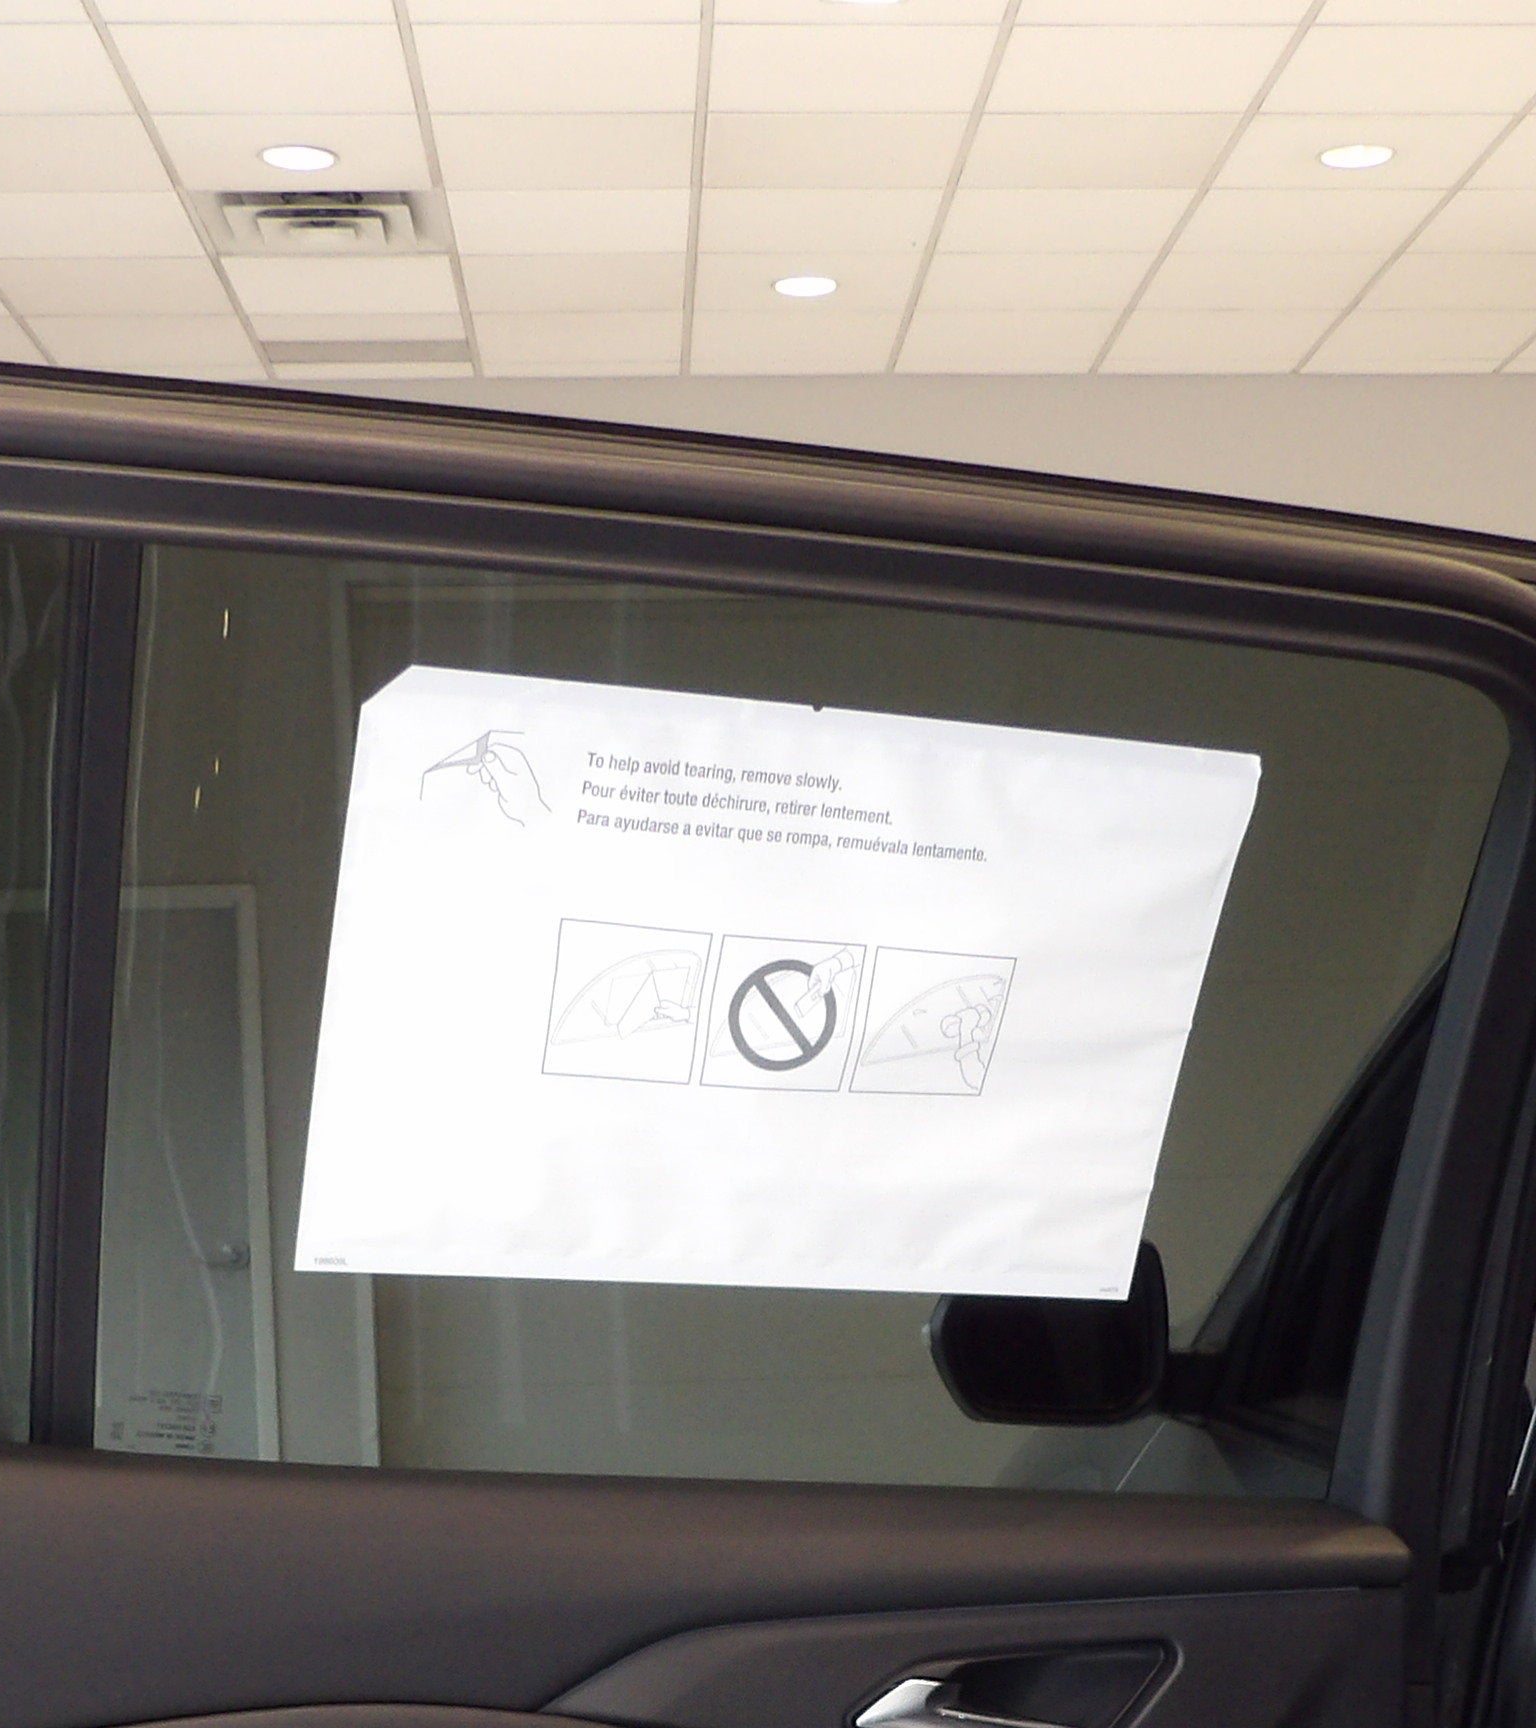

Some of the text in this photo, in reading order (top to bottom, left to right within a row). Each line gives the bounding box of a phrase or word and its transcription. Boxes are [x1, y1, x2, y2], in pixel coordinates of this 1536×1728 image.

[587, 752, 842, 793] To help avoid tearing, remove slowly.
[582, 780, 893, 825] Pour éviter toute déchirure, retirer lentement.
[577, 809, 988, 863] Para ayudarse a evitar que se rompa, remuévala lentamente.
